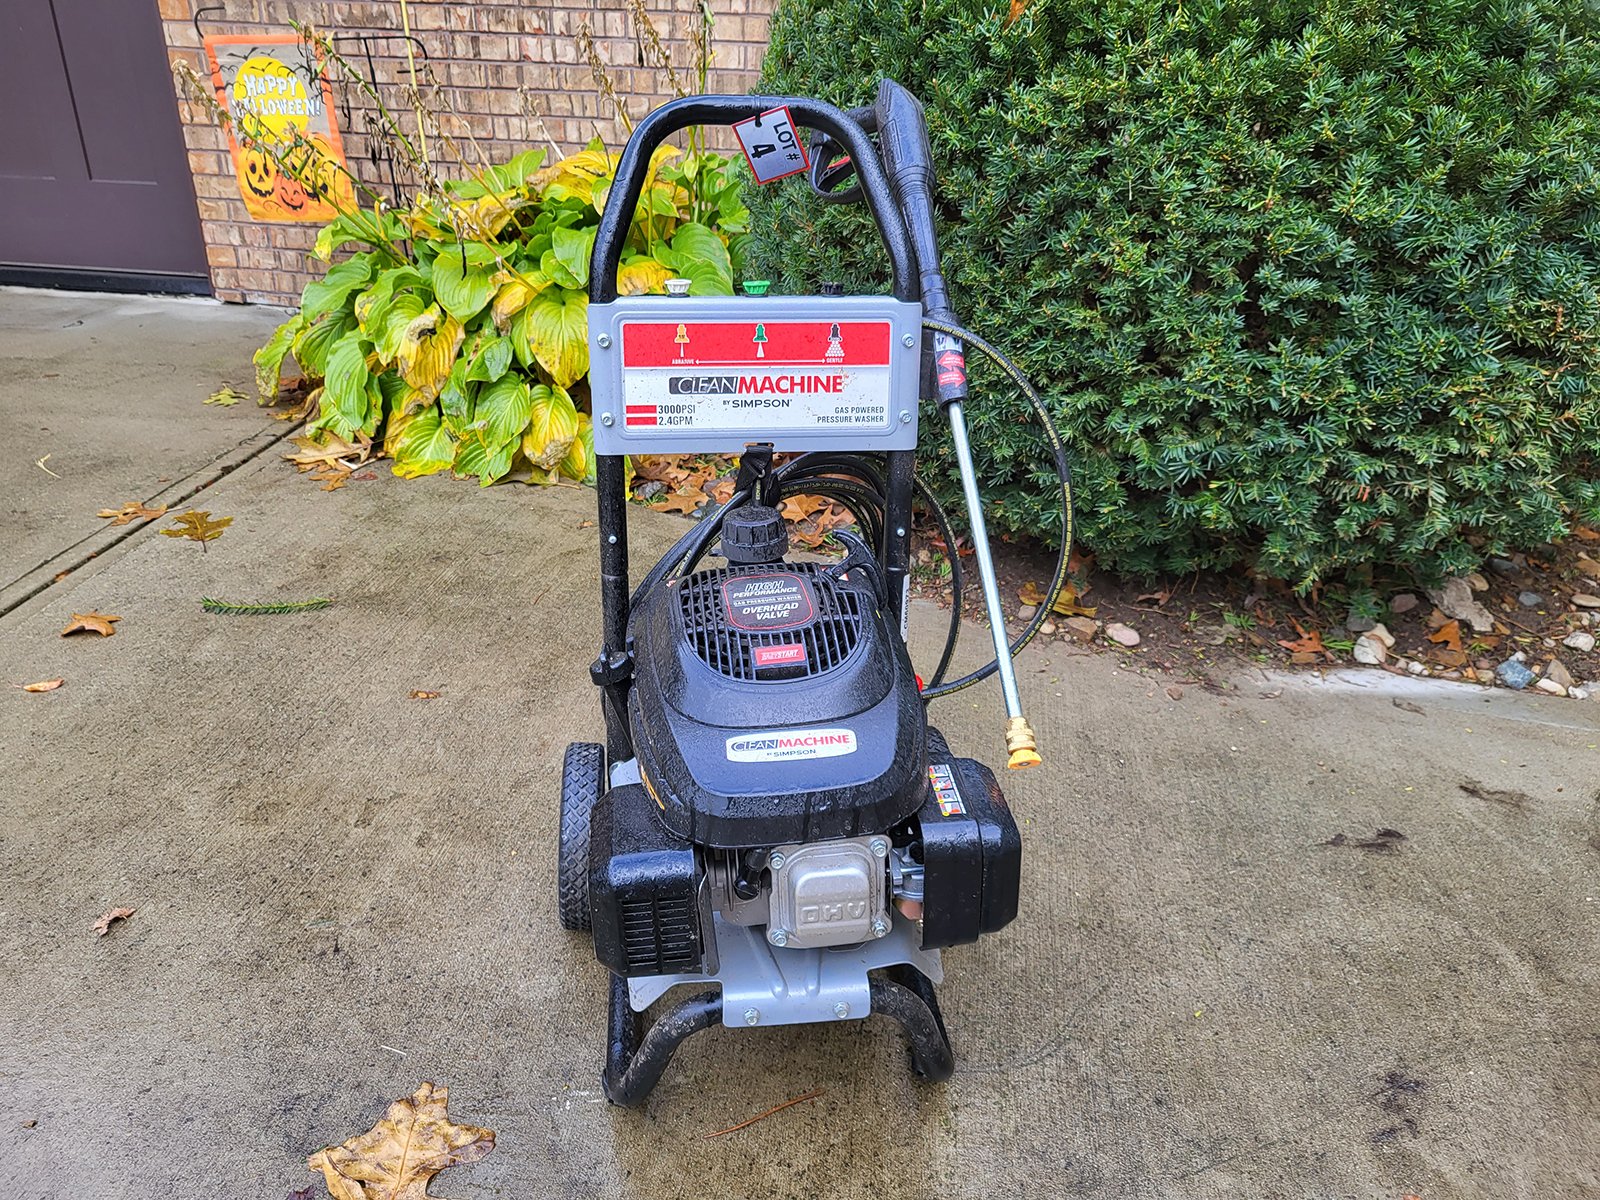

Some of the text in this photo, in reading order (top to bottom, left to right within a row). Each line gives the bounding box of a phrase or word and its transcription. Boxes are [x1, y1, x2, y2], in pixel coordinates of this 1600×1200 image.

[243, 74, 298, 97] HAPPY
[773, 121, 797, 151] LOT
[751, 143, 776, 159] 4
[732, 399, 790, 408] SIMPSON
[834, 406, 885, 414] GAS POWERED
[817, 415, 884, 424] PRESSURE WASHER
[745, 580, 785, 592] HIGH
[733, 586, 798, 599] PERFORMANCE
[742, 602, 799, 614] OVERHEAD
[756, 609, 790, 620] VALVE
[773, 749, 817, 757] SIMPSON
[801, 901, 866, 924] OHV
